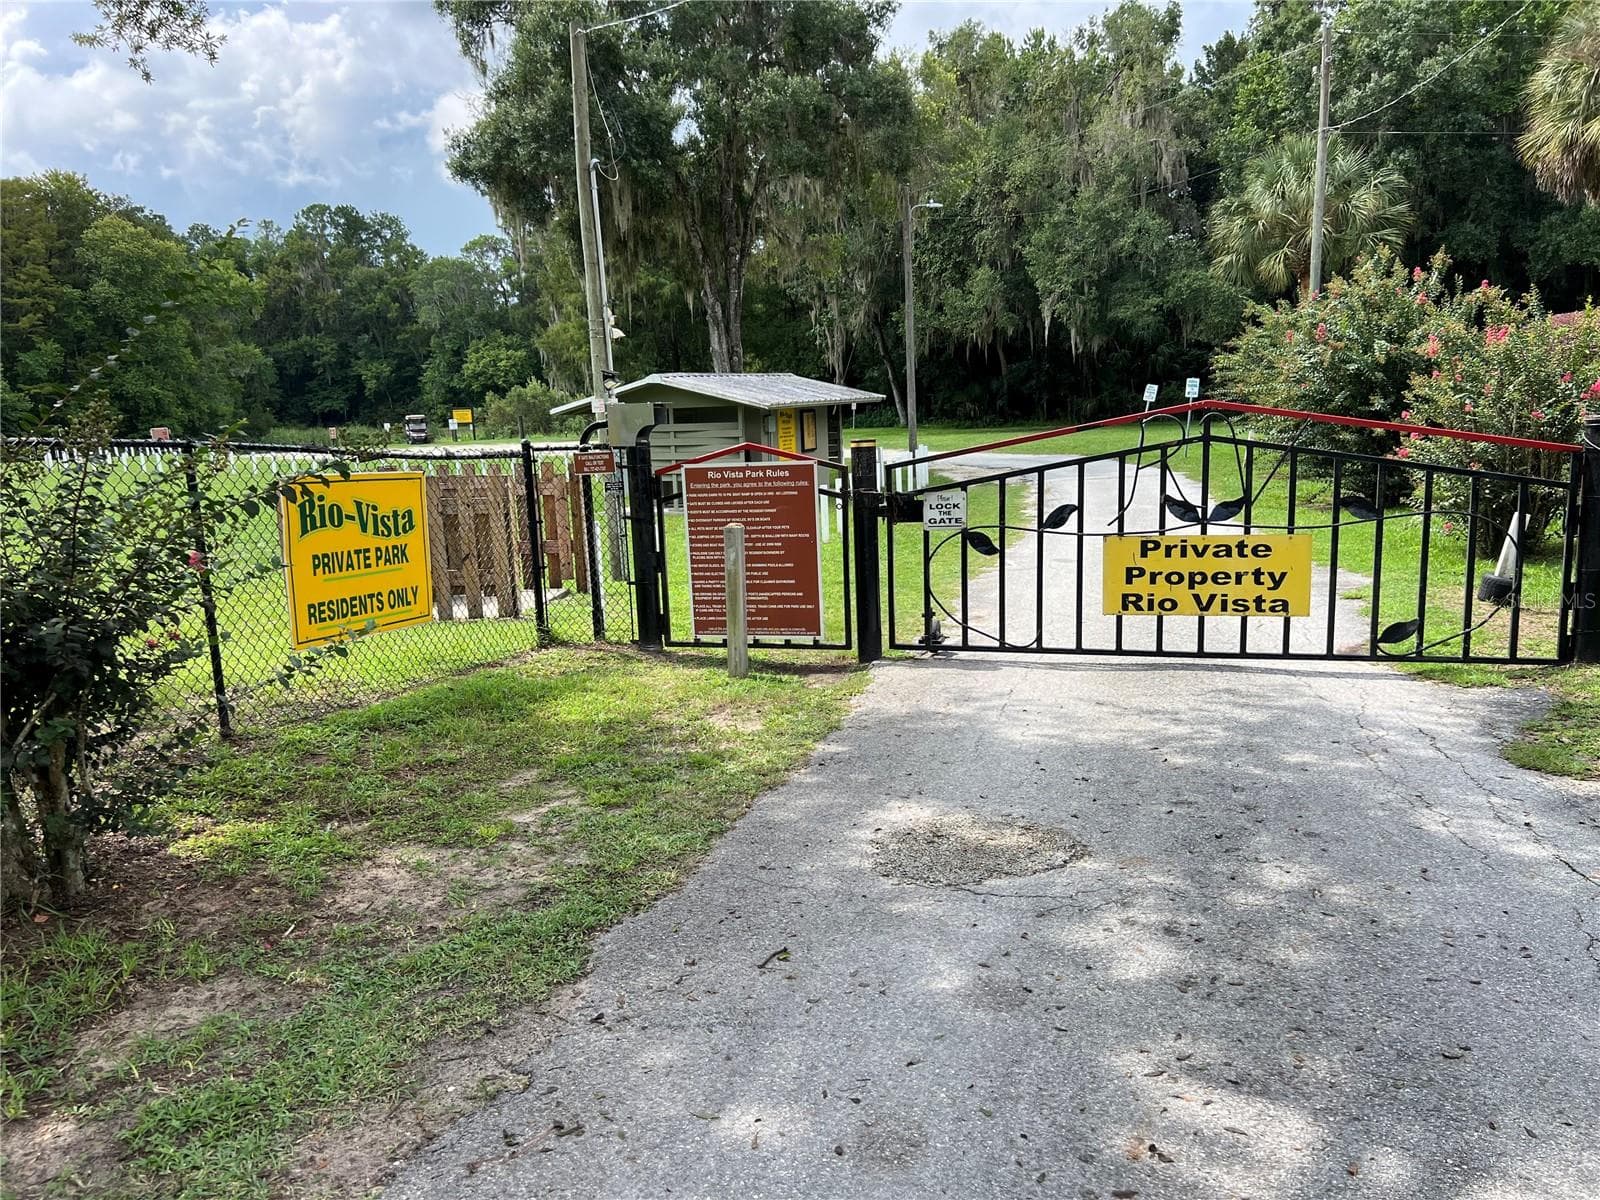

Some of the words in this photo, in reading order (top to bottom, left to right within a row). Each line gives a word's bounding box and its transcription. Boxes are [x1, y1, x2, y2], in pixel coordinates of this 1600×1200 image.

[297, 494, 416, 539] Rio-Vista
[312, 548, 372, 576] PRIVATE
[375, 544, 409, 568] PARK
[1140, 540, 1273, 558] Private
[1125, 567, 1288, 590] Property
[307, 592, 384, 625] RESIDENTS
[388, 585, 419, 610] ONLY
[1121, 593, 1178, 612] Rio
[1192, 593, 1290, 613] Vista
